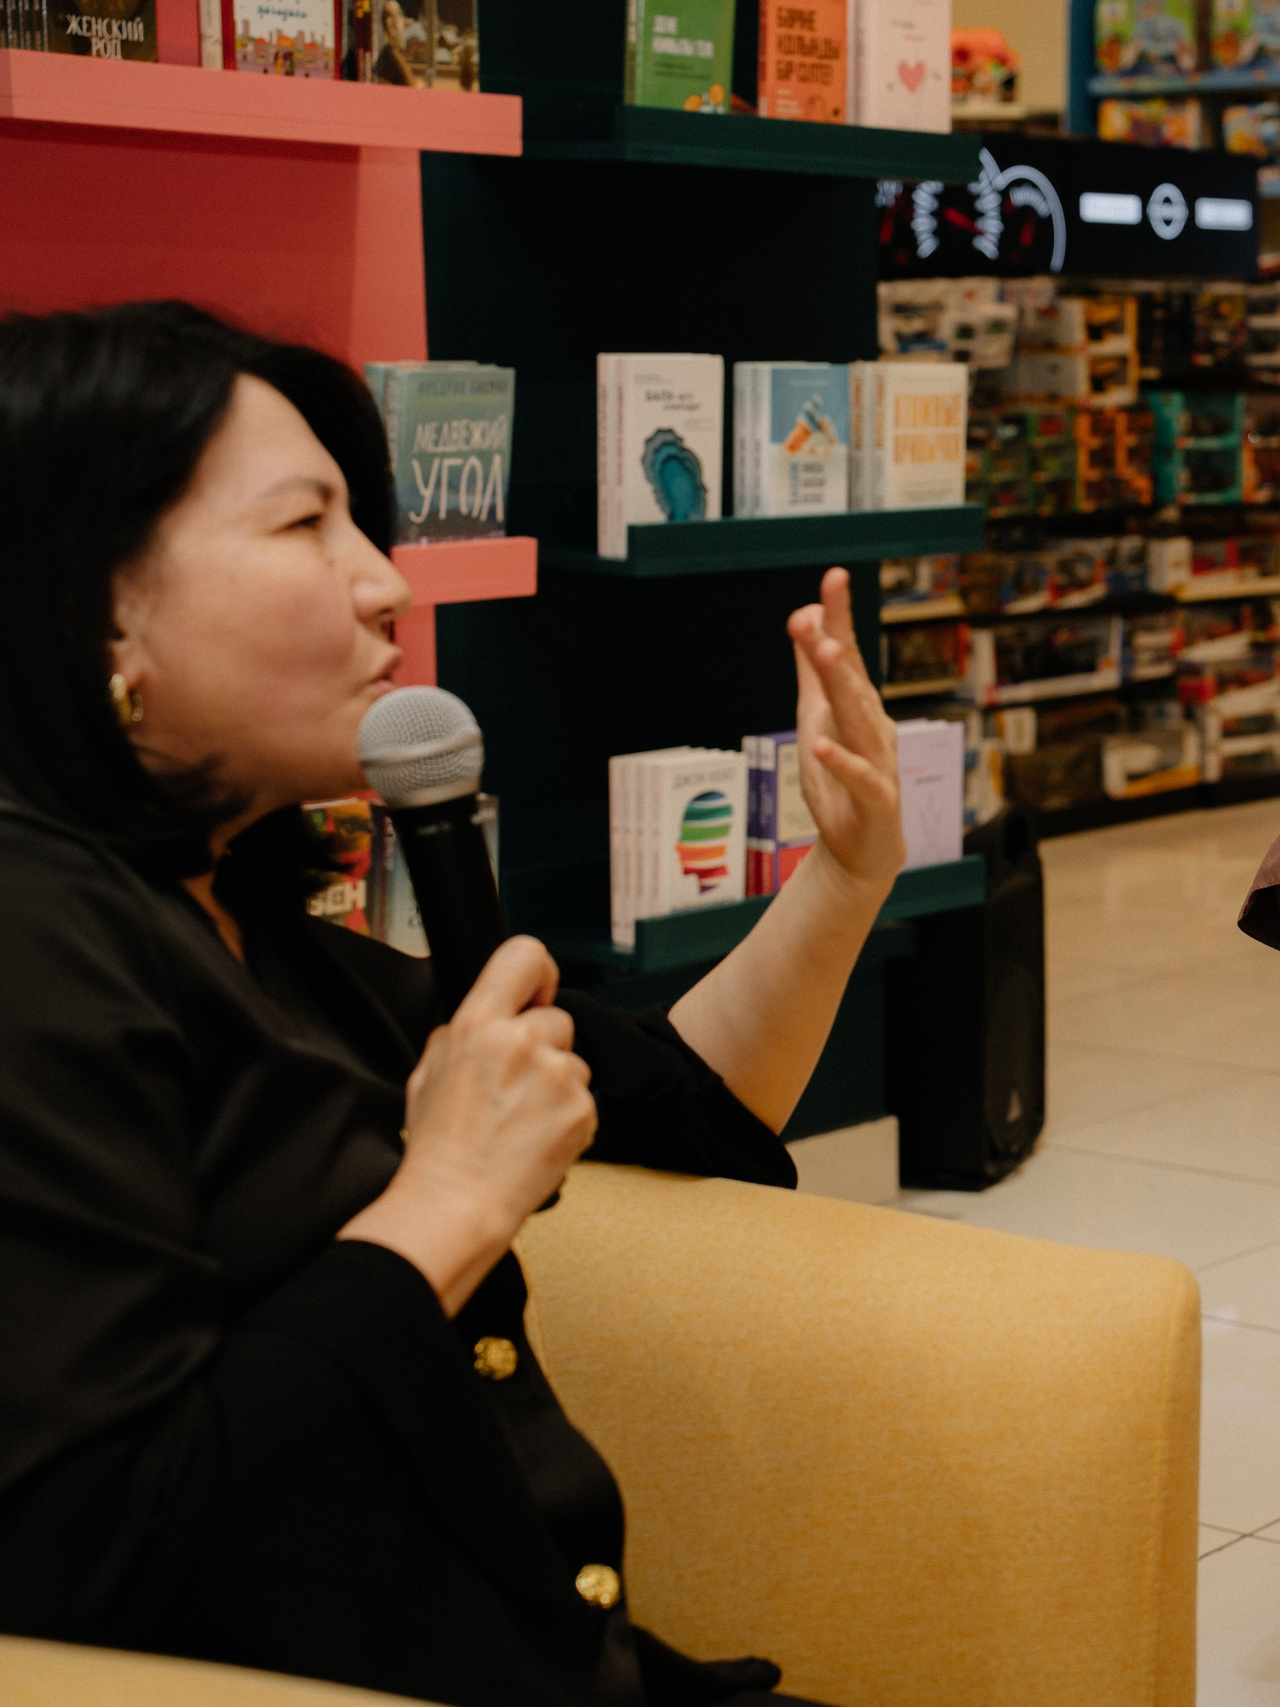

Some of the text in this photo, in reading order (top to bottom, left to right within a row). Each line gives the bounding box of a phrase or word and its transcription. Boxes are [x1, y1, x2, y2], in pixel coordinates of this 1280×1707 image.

[65, 14, 144, 42] ЖЕНСКИЙ
[91, 37, 123, 60] РОД
[412, 414, 509, 454] МЕДВЕЖИЙ
[408, 453, 505, 524] УГОЛ
